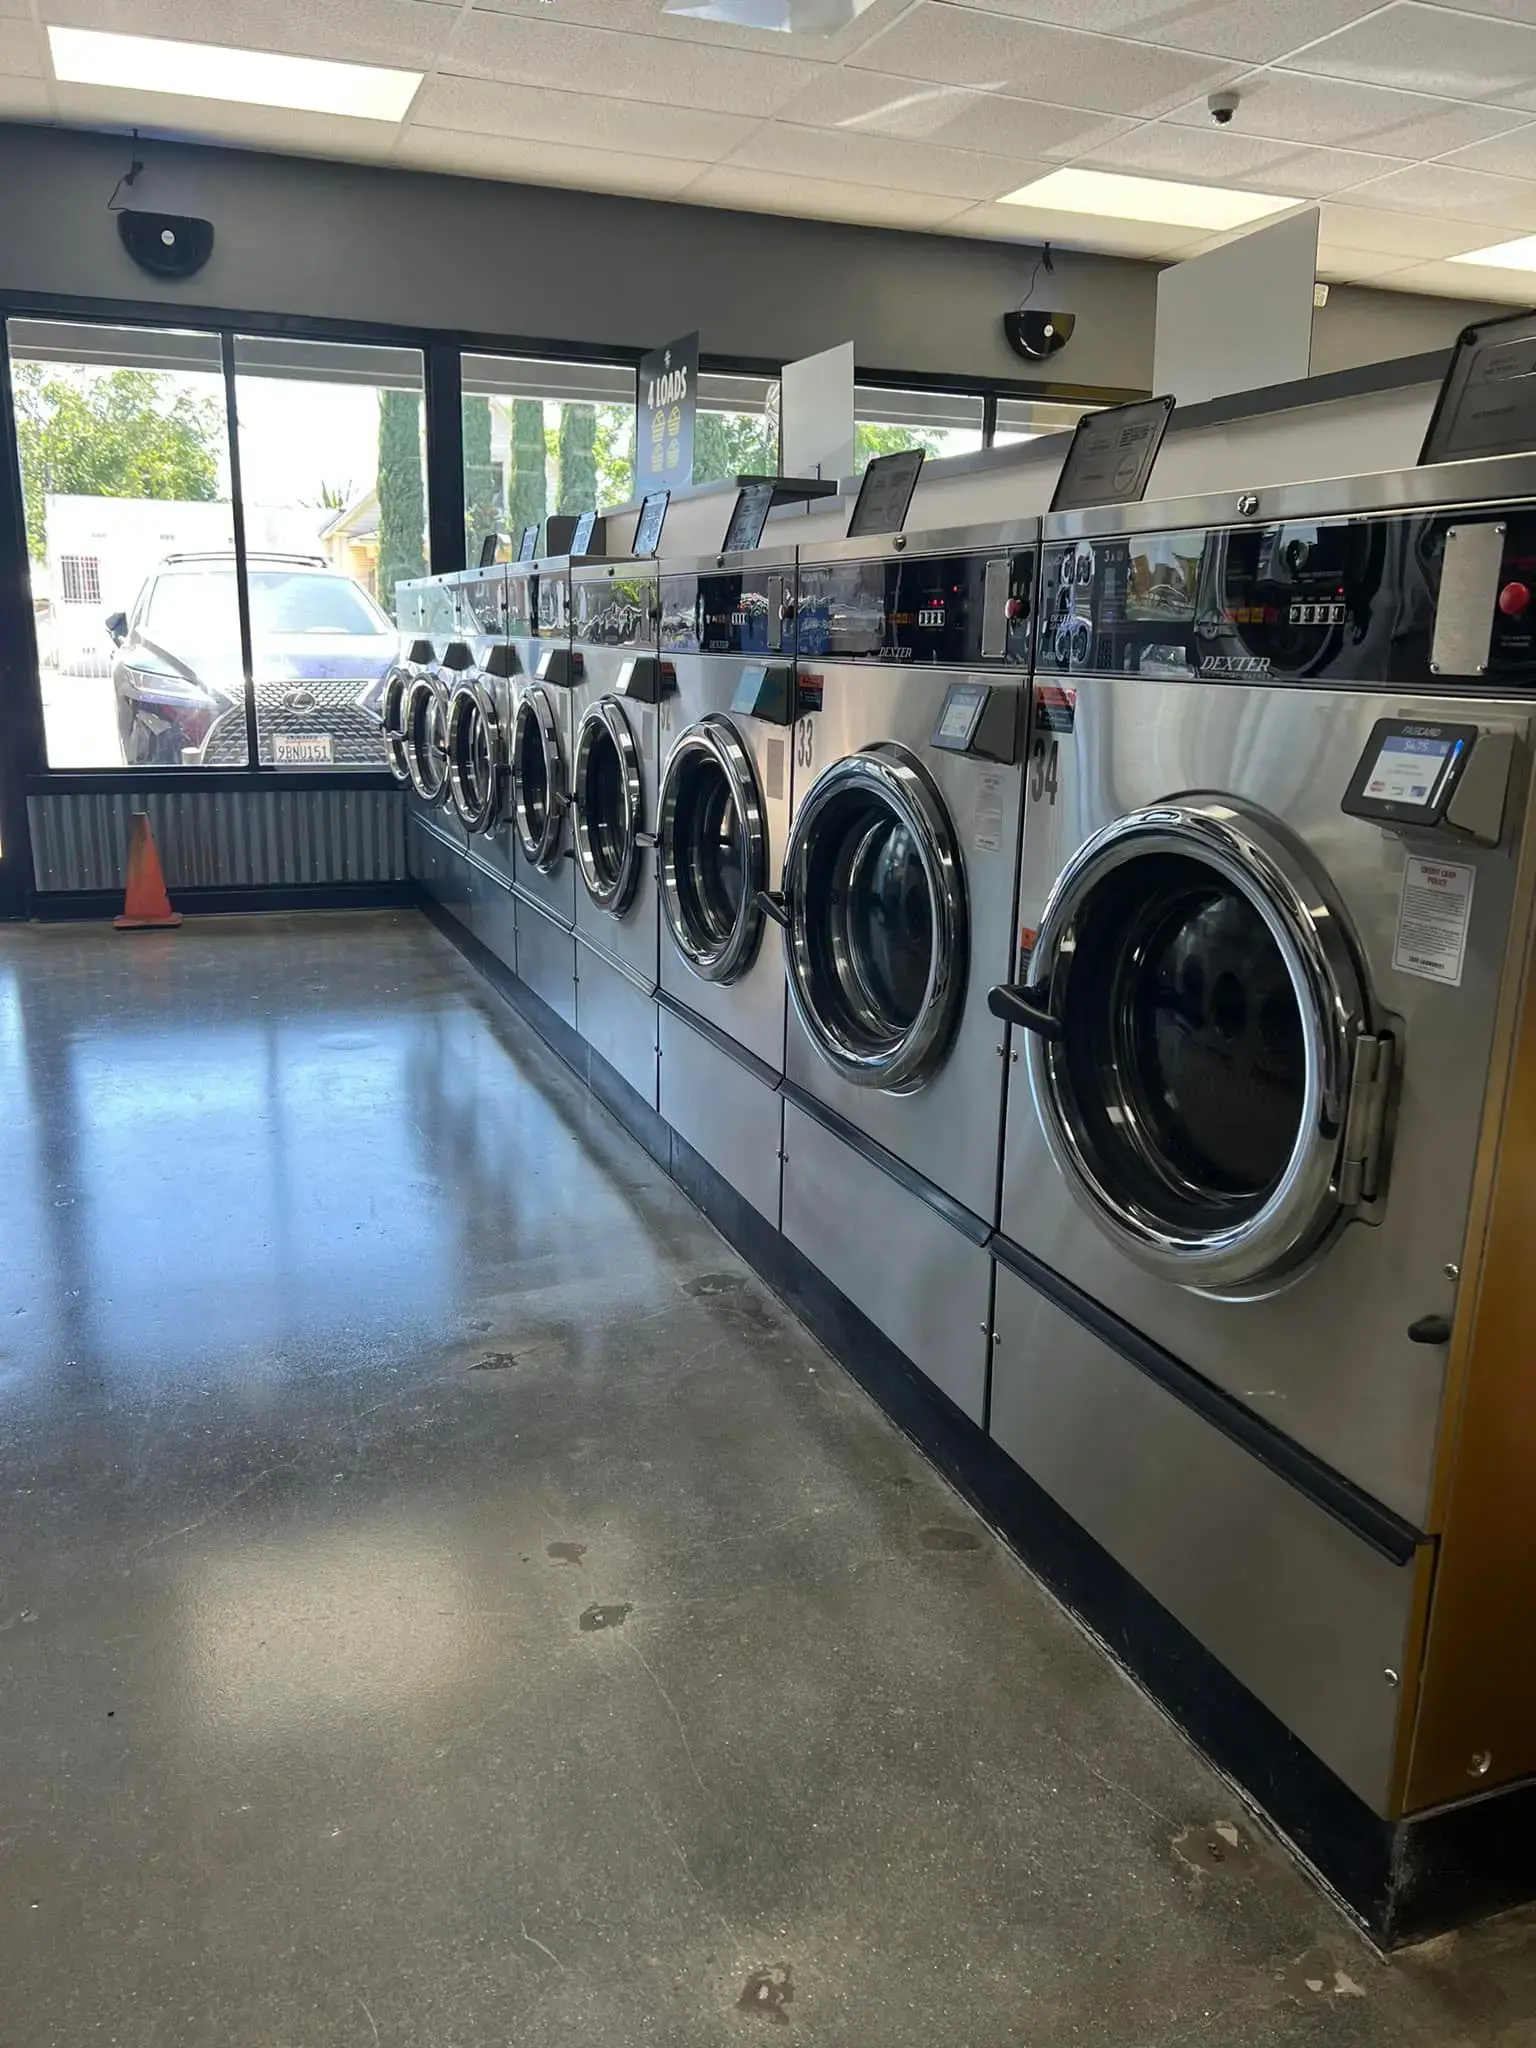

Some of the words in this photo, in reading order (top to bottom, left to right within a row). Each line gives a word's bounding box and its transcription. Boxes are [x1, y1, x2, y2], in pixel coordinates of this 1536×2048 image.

[647, 380, 655, 410] 4
[656, 365, 688, 408] LOADS
[878, 646, 912, 658] DEXTER
[1200, 655, 1272, 673] DEXTER
[278, 745, 327, 759] 9BNU151
[797, 718, 814, 769] 33
[1031, 737, 1059, 806] 34
